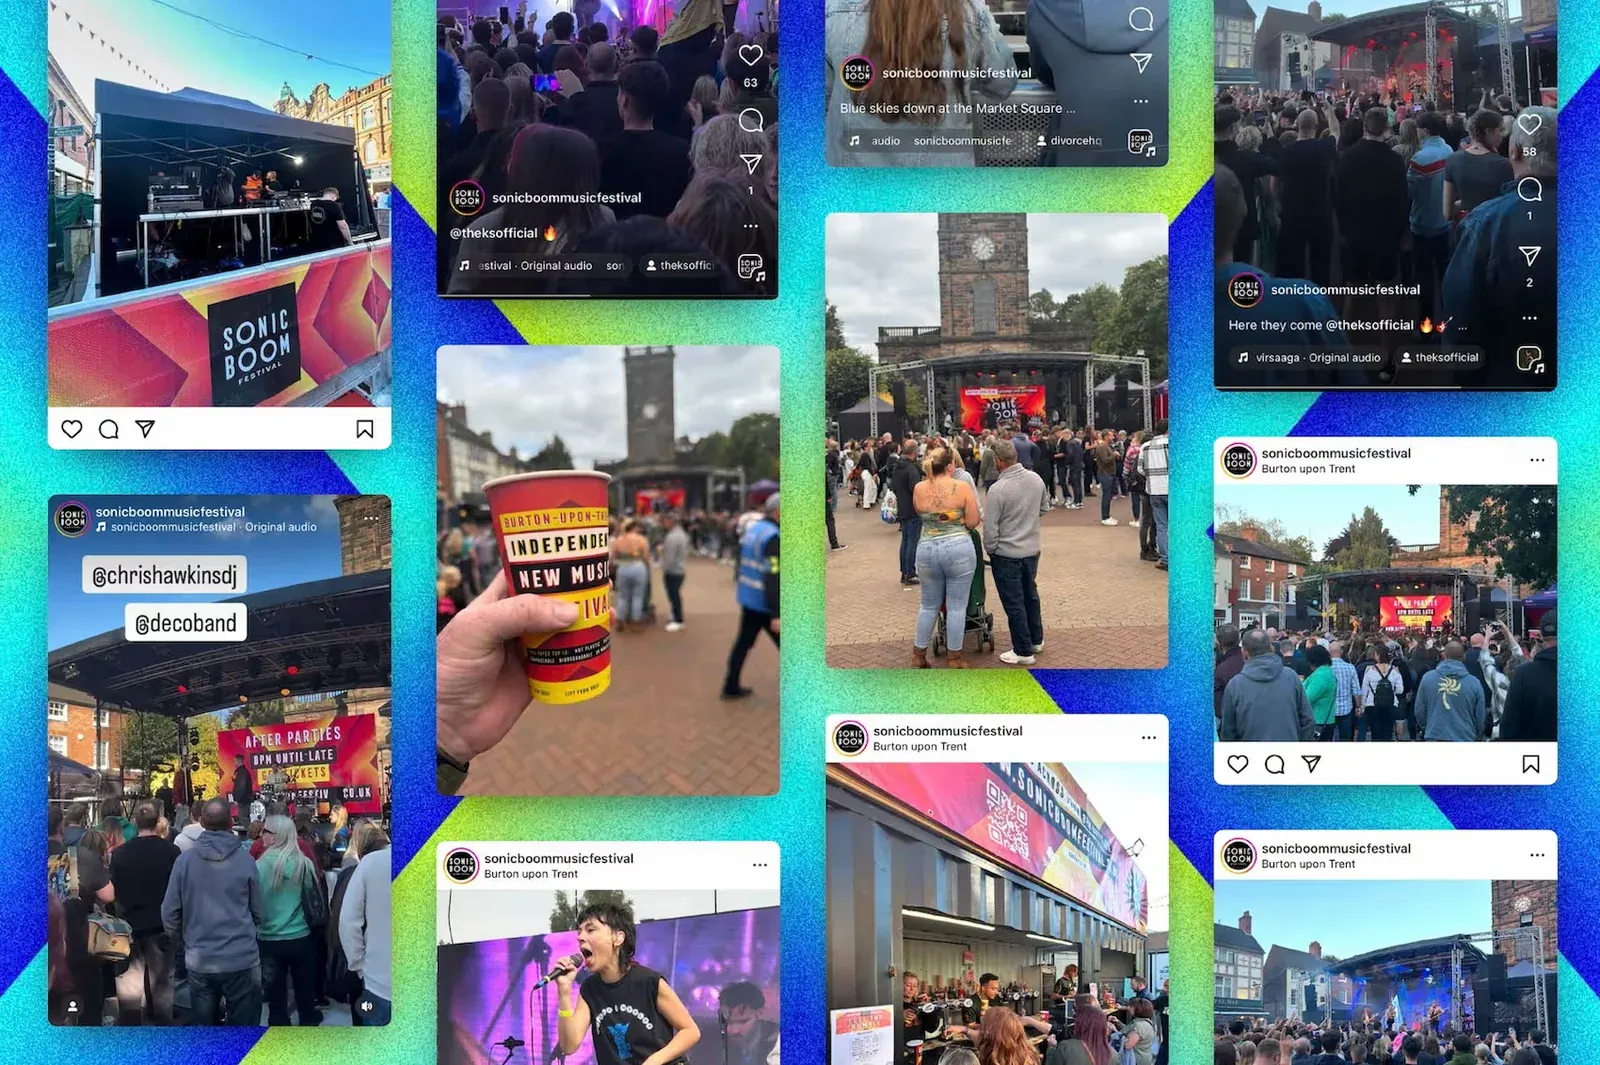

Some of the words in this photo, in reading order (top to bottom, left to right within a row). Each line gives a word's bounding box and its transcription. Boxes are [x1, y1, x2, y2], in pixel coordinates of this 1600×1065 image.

[223, 308, 289, 351] SONIC
[224, 332, 291, 381] BOOM
[238, 360, 282, 386] FESTIVAL
[518, 568, 561, 589] NEW
[245, 732, 282, 749] AFTER
[287, 726, 341, 744] PARTIES
[253, 754, 272, 766] 8PM
